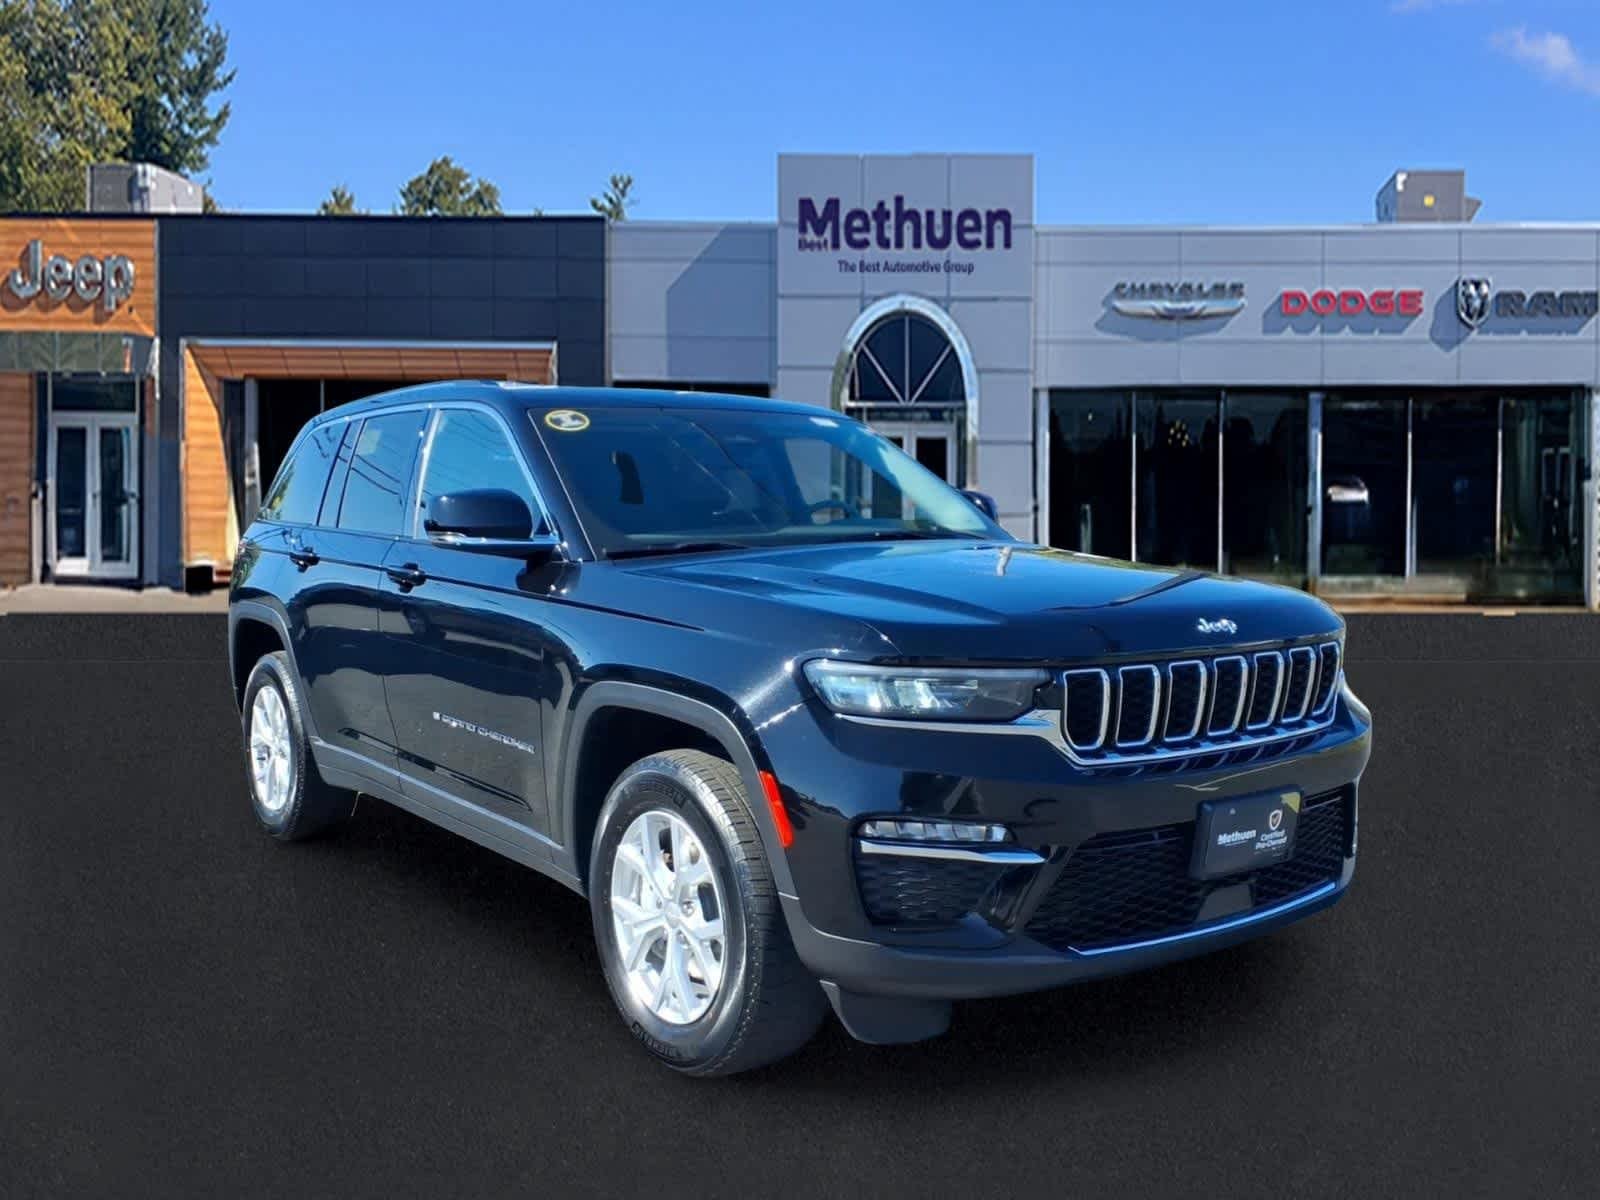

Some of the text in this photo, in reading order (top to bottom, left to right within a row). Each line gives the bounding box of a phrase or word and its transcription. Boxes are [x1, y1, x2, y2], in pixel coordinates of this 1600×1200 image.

[798, 195, 1012, 250] Methuen
[9, 239, 135, 312] Jeep
[838, 260, 974, 275] The Best Automotive Group
[1114, 281, 1244, 299] CHRYSLER
[1282, 290, 1424, 315] DODGE
[1495, 291, 1599, 318] RAM
